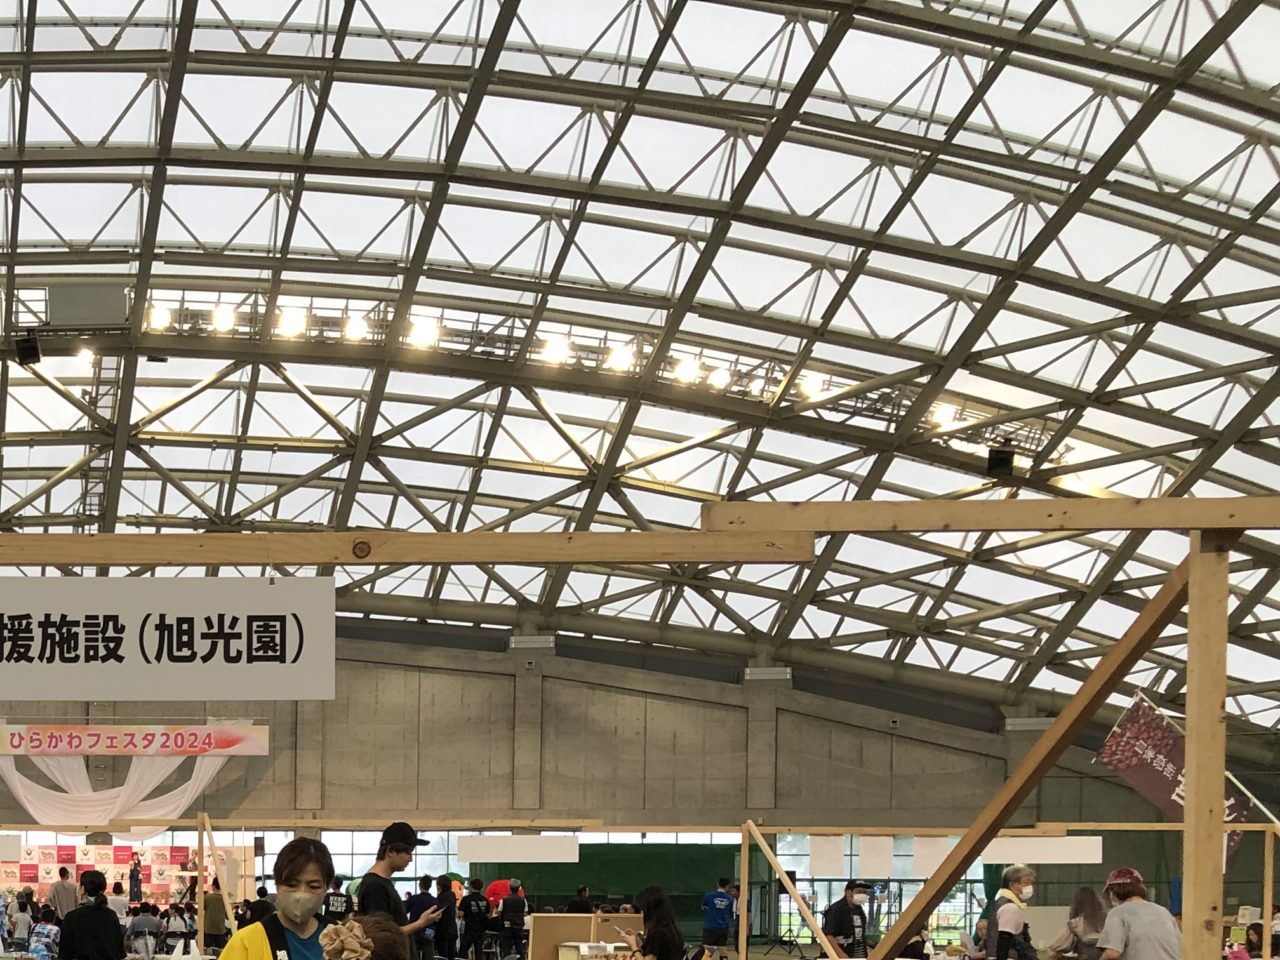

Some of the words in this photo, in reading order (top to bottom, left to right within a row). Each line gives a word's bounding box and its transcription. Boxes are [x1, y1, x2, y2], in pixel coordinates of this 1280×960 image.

[9, 731, 215, 750] ひらかわフェスタ2024
